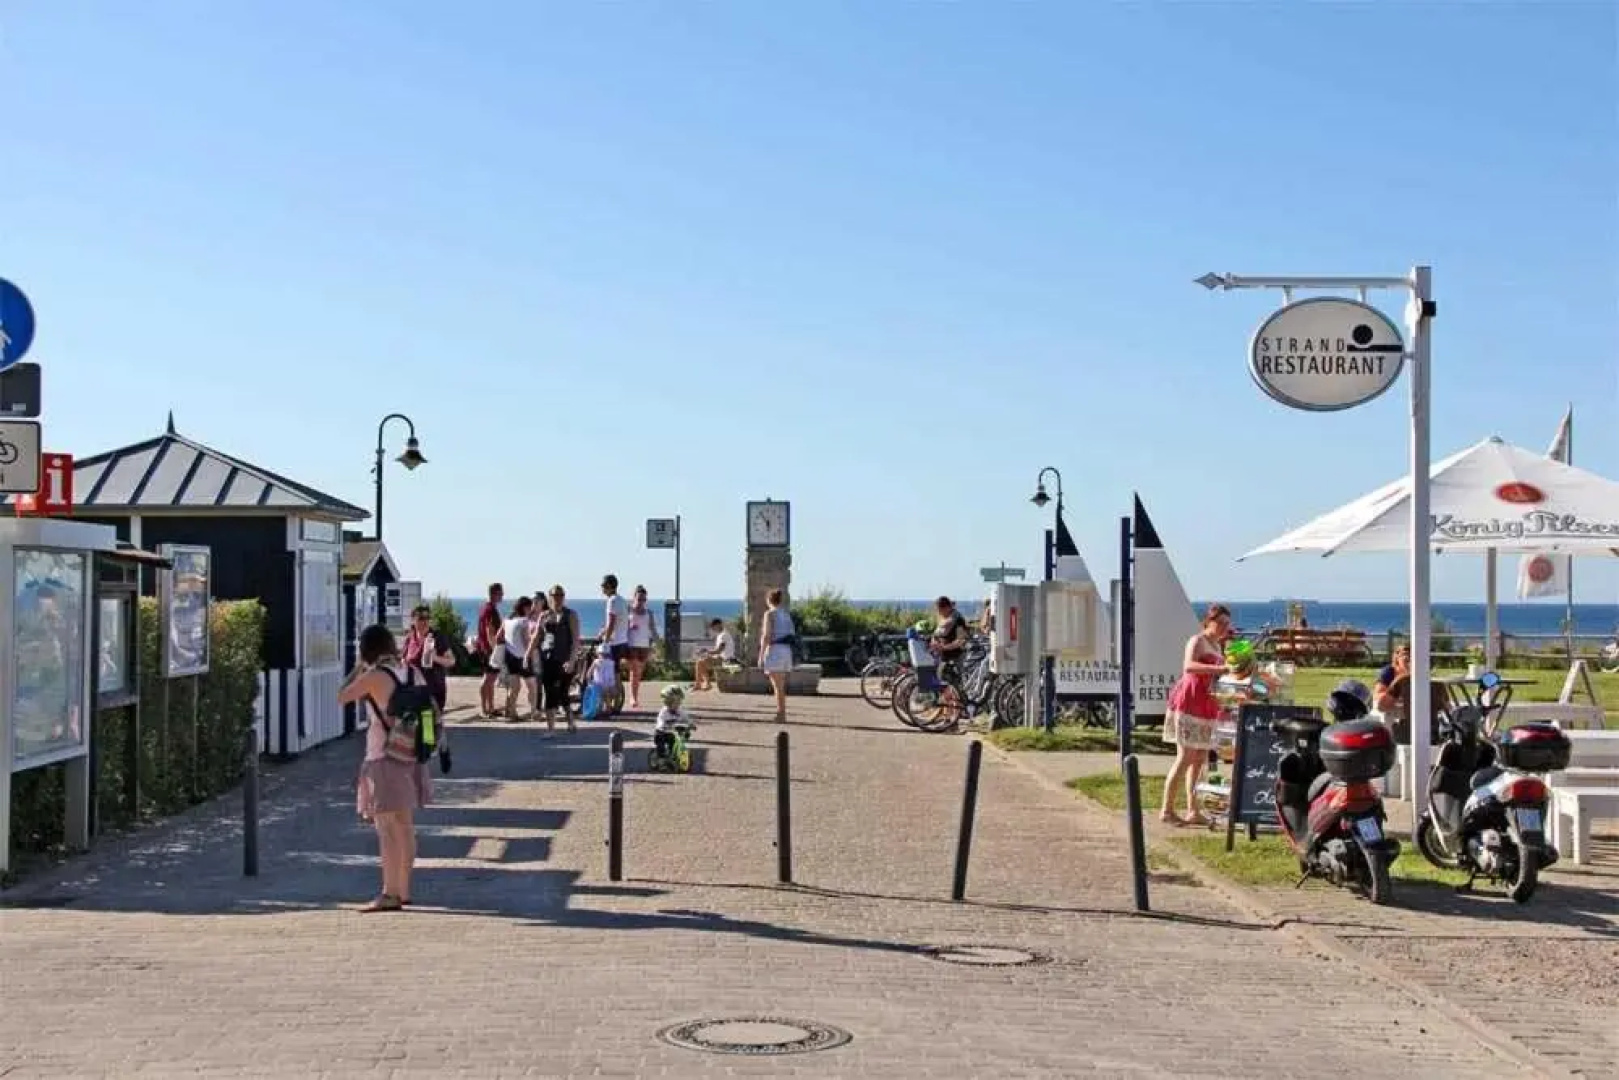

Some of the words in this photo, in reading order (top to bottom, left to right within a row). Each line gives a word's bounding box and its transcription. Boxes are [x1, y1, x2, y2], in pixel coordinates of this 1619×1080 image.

[1261, 337, 1345, 352] STRAND
[1261, 355, 1386, 375] RESTAURANT
[1429, 514, 1524, 538] König
